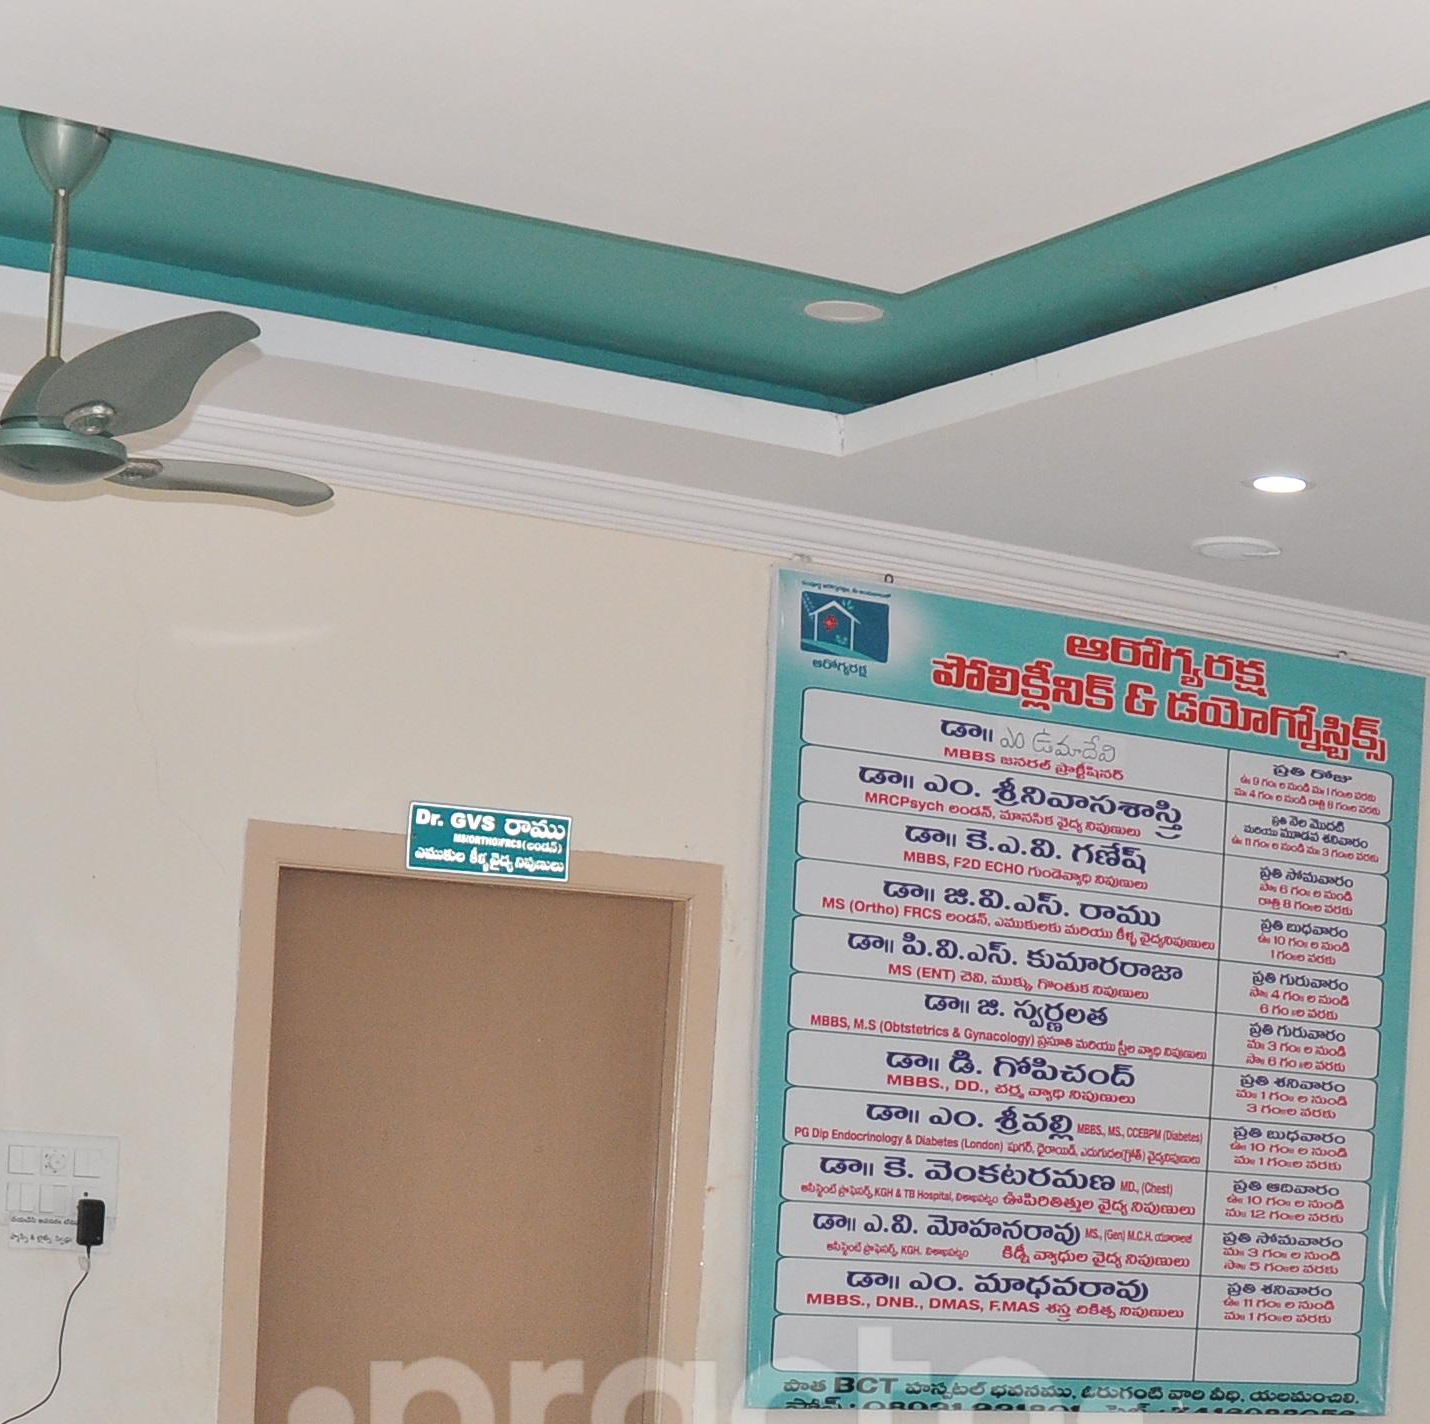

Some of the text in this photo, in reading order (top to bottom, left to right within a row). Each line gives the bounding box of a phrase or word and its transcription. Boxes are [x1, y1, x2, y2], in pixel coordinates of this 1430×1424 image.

[1067, 635, 1267, 696] ఆరోగ్యరక్ష
[1125, 684, 1158, 717] &
[944, 747, 995, 762] MBBS
[865, 792, 944, 812] MRCPsych
[416, 809, 565, 840] Dr. GVS రాము
[903, 851, 949, 868] MBBS,
[954, 857, 981, 870] F2D
[986, 859, 1024, 876] ECHO
[822, 896, 845, 910] MS
[850, 900, 899, 918] (Ortho)
[904, 906, 942, 921] FRCS
[1080, 902, 1161, 928] రాము
[888, 963, 912, 977] MS
[916, 966, 956, 983] (ENT)
[810, 1014, 850, 1030] MBBS,
[953, 1025, 961, 1038] &
[794, 1126, 1004, 1151] PG Endocrinology & Diabetes (London)
[874, 1186, 893, 1198] KGH
[904, 1189, 916, 1199] TB
[1142, 1182, 1173, 1197] (Chest)
[929, 1298, 984, 1312] DMAS,
[989, 1300, 1040, 1313] F.MAS
[834, 1377, 899, 1394] BCT
